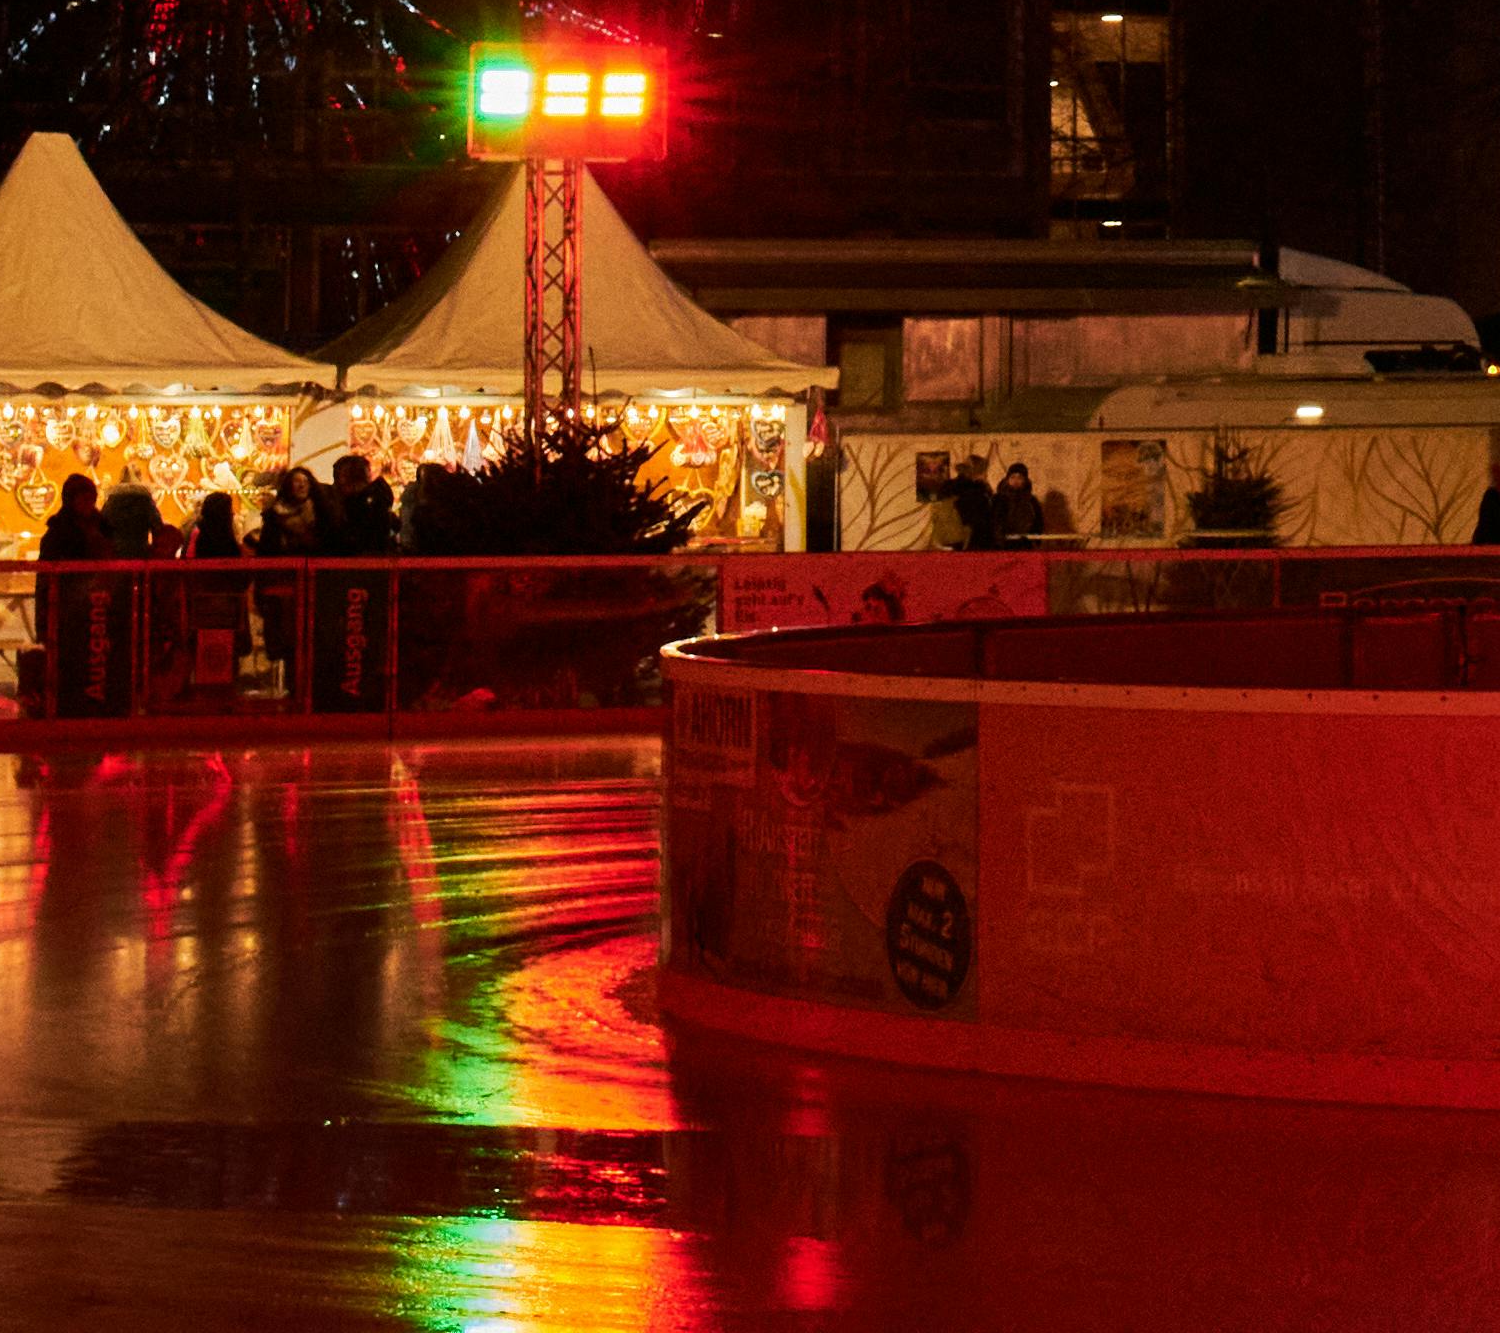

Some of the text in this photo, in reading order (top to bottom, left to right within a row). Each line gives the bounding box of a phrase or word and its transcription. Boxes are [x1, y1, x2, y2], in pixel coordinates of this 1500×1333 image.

[85, 590, 113, 702] Ausgang
[339, 586, 370, 698] Ausgang
[940, 910, 955, 940] 2
